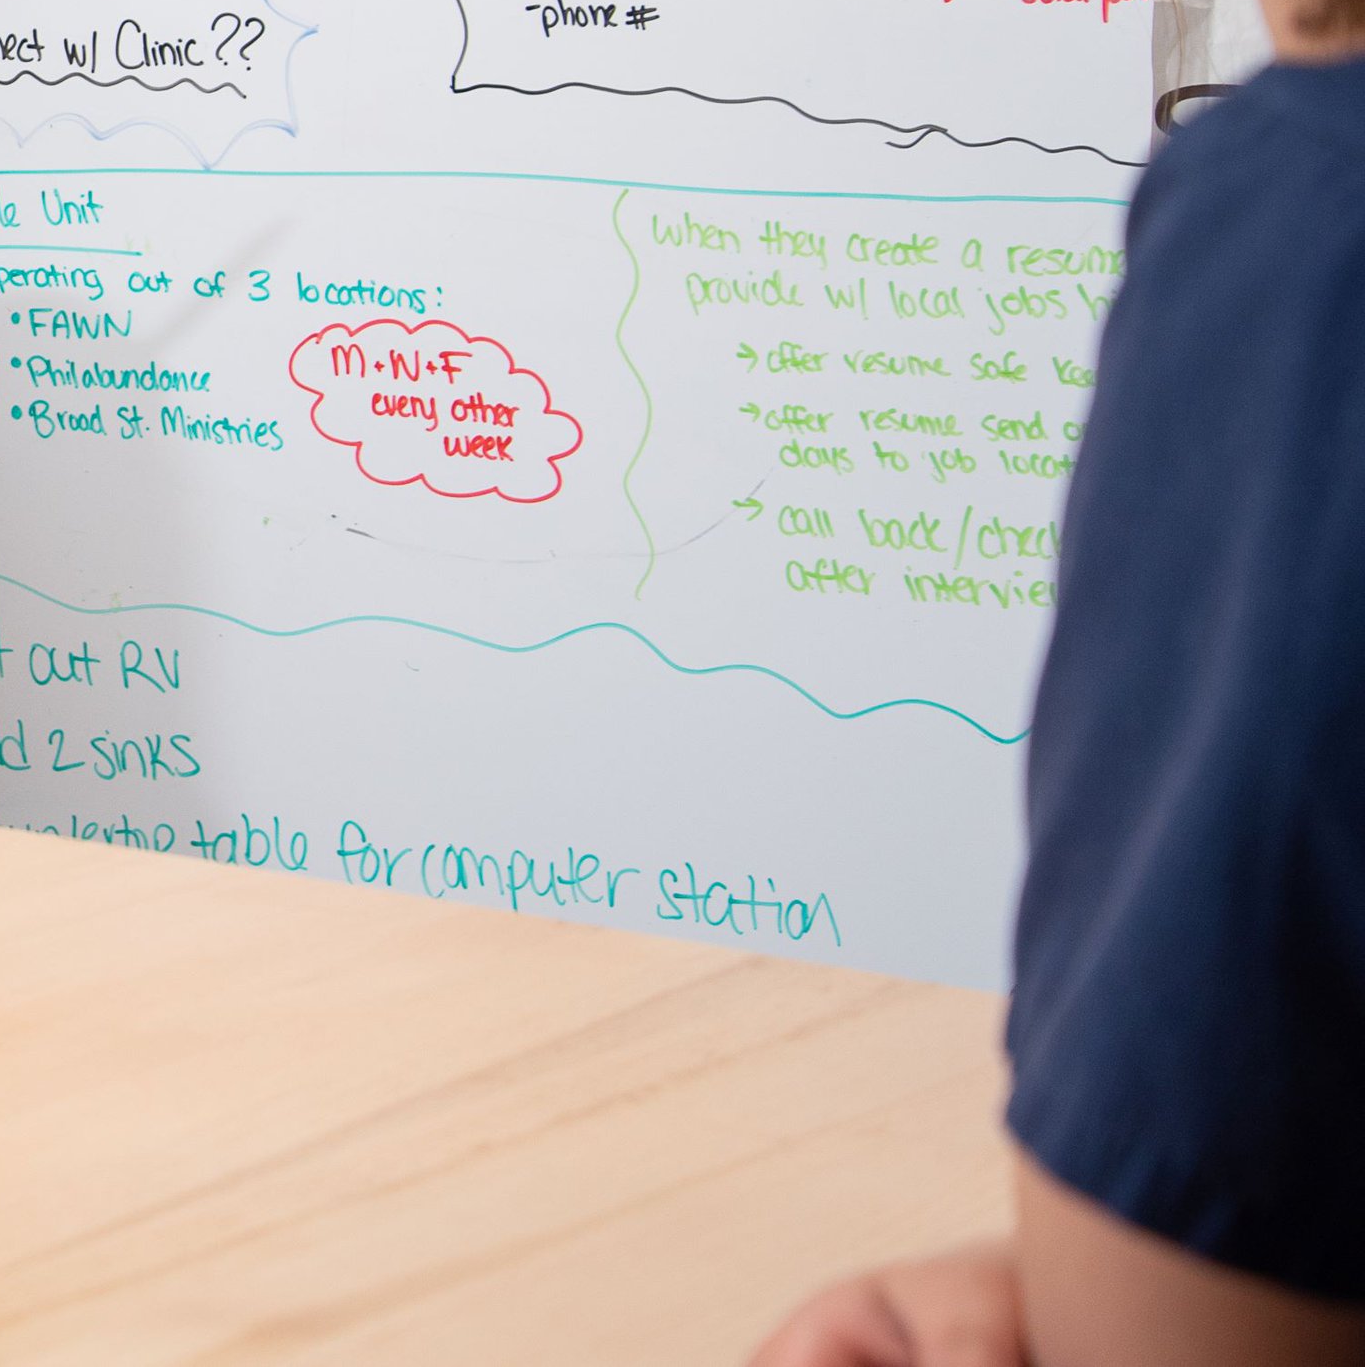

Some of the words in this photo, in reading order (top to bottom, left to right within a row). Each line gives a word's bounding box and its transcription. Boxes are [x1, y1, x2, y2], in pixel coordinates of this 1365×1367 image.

[624, 4, 660, 31] #
[63, 29, 98, 74] w/
[41, 188, 105, 226] Unit
[759, 220, 827, 269] they
[846, 232, 940, 266] create
[961, 237, 984, 272] a
[128, 269, 173, 295] out
[192, 269, 226, 298] of
[246, 270, 273, 303] 3
[297, 271, 447, 315] locations:
[685, 270, 805, 316] provide
[889, 280, 964, 320] local
[976, 285, 1068, 336] jobs
[28, 307, 133, 339] FAWN
[26, 353, 211, 394] Philabundance
[766, 340, 829, 375] offer
[844, 347, 952, 377] resume
[969, 349, 1029, 386] safe
[28, 402, 107, 439] Broad
[116, 405, 153, 438] St.
[161, 408, 285, 451] Ministries
[371, 393, 438, 432] every
[451, 393, 521, 429] other
[765, 404, 835, 434] offer
[858, 409, 963, 437] resume
[981, 410, 1048, 442] send
[443, 435, 515, 463] week
[778, 437, 855, 475] days
[872, 441, 910, 472] to
[921, 445, 977, 485] job
[777, 504, 835, 537] call
[785, 558, 876, 596] after
[27, 641, 103, 687] out
[119, 641, 185, 693] RV
[47, 726, 85, 773] 2
[89, 729, 201, 781] sinks
[189, 809, 310, 873] table
[336, 820, 418, 889] for
[655, 868, 842, 948] station
